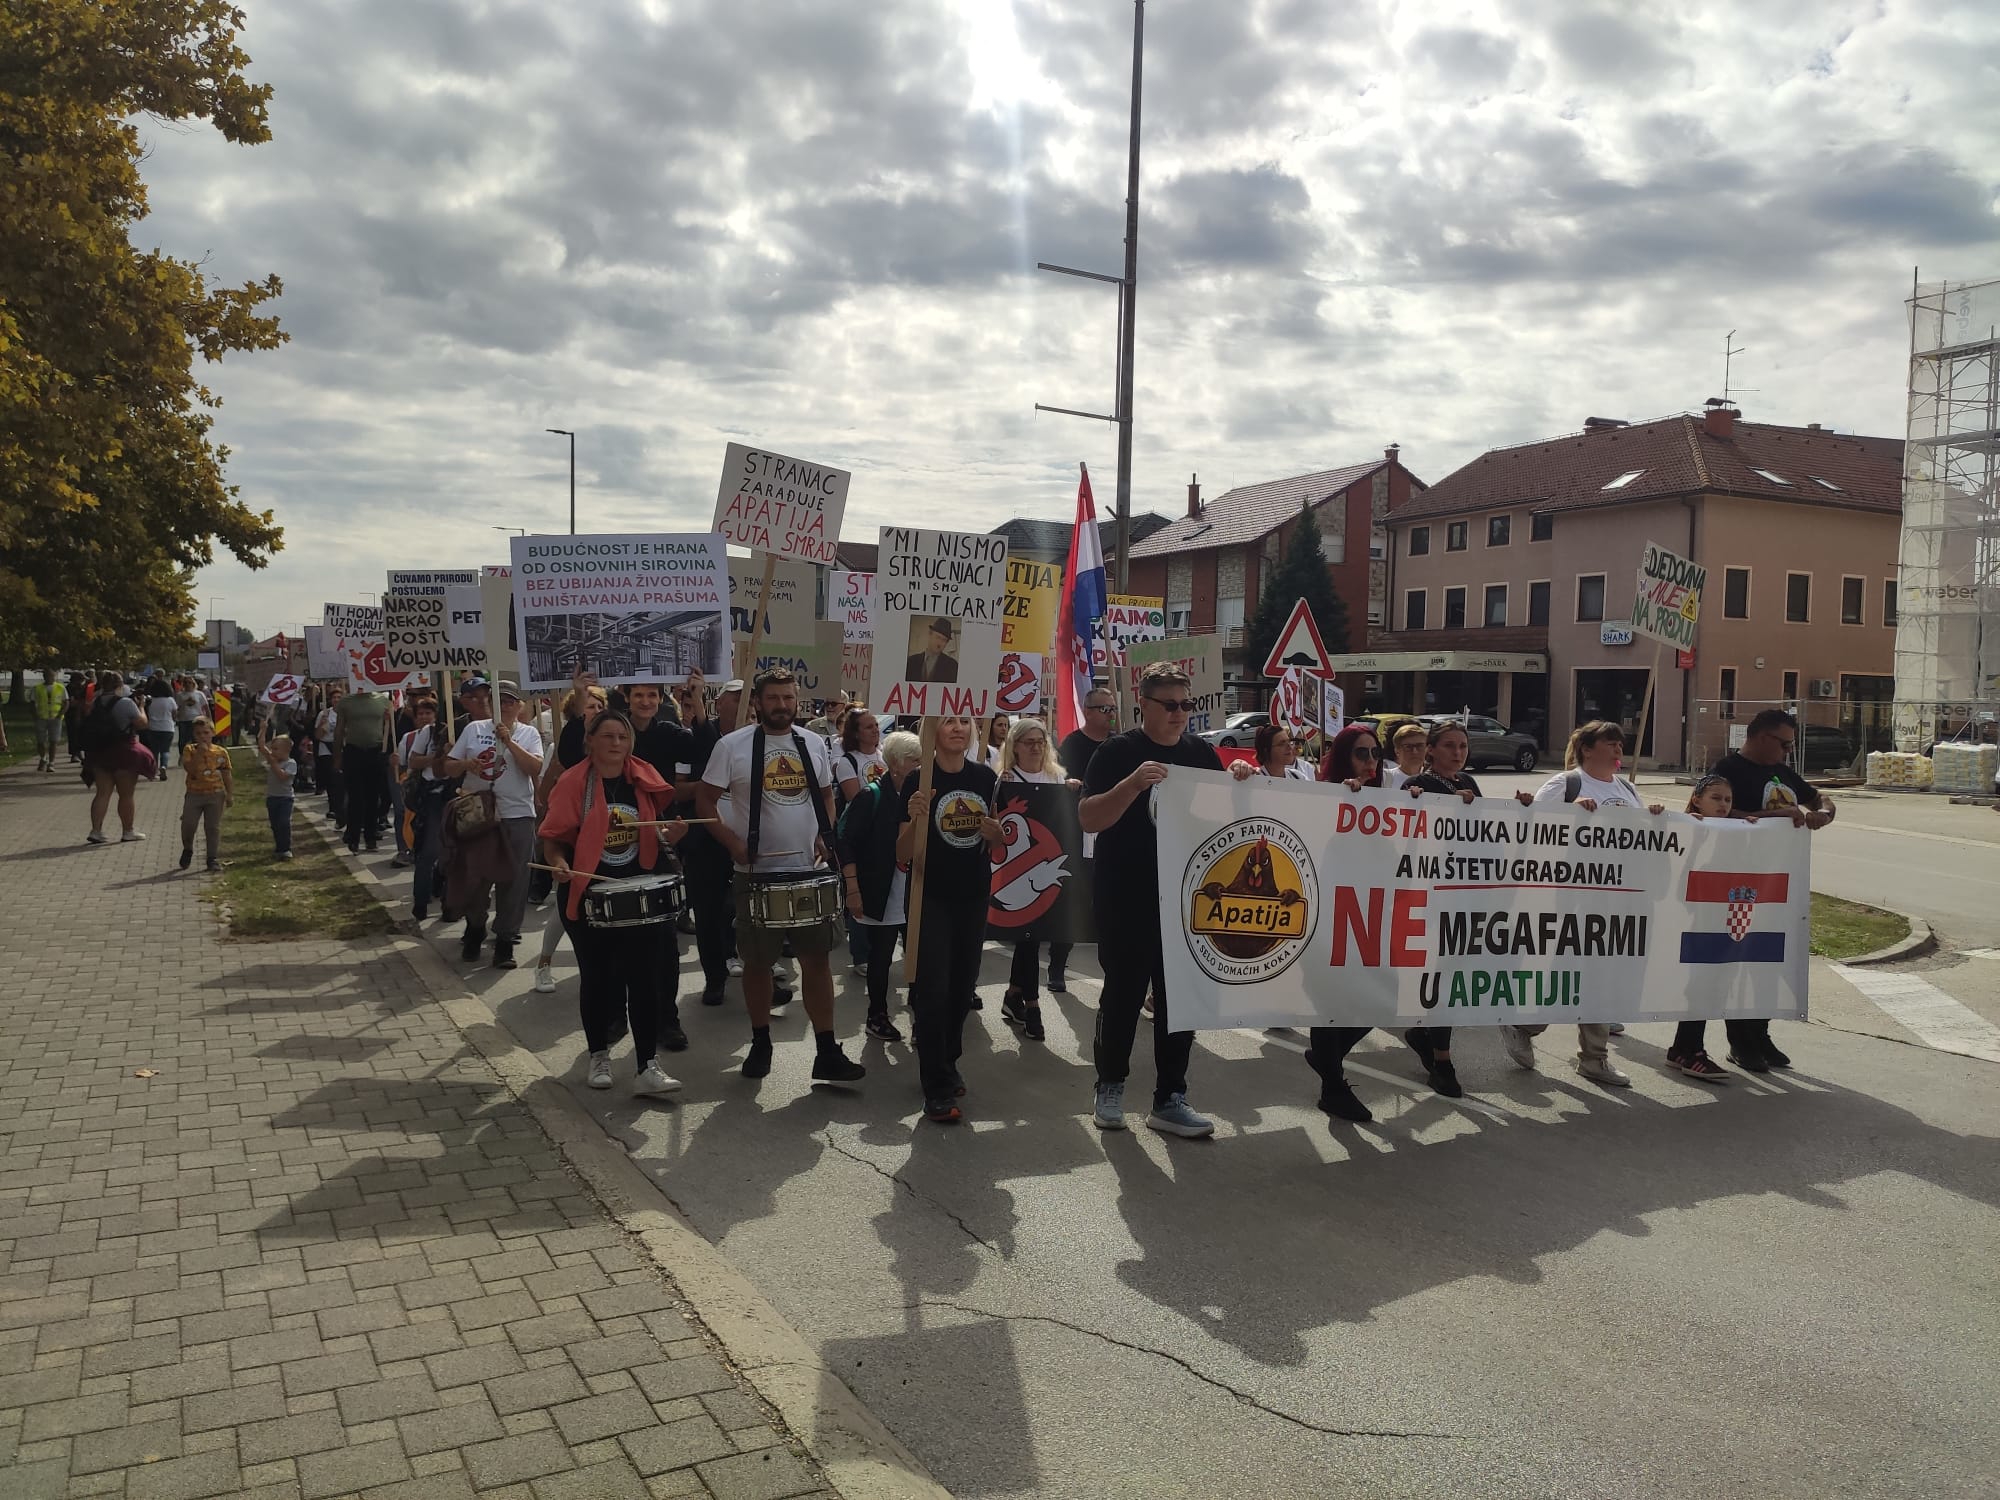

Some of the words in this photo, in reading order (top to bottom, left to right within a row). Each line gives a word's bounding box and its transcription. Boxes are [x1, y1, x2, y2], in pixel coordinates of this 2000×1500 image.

[744, 452, 837, 495] STRANAC
[739, 478, 825, 511] ZARAĐUJE
[726, 494, 825, 537] APATIJA
[528, 541, 630, 557] BUDUĆNOST
[633, 543, 649, 555] JE
[653, 543, 708, 555] HRANA
[718, 519, 770, 548] GUTA
[781, 532, 837, 562] SMRAD
[937, 533, 1006, 563] NISMO
[434, 573, 473, 584] PRIRODU
[522, 563, 546, 575] OD
[550, 561, 637, 573] OSNOVNIH
[641, 559, 716, 571] SIROVINA
[526, 578, 555, 591] BEZ
[559, 576, 632, 589] UBIJANJA
[636, 573, 714, 587] ŽIVOTINJA
[392, 585, 445, 596] POŠTUJEMO
[522, 597, 527, 608] I
[531, 592, 640, 608] UNIŠTAVANJA
[643, 589, 719, 604] PRAŠUMA
[908, 581, 920, 590] MI
[932, 582, 959, 593] SMO
[384, 598, 444, 613] NAROD
[1631, 592, 1650, 630] NA
[386, 614, 441, 629] REKAO
[1602, 632, 1630, 641] SHARK
[388, 649, 441, 669] VOLJU
[883, 682, 927, 714] AM
[940, 686, 988, 716] NAJ
[771, 776, 806, 786] Apatija
[948, 817, 982, 828] Apatija
[1336, 803, 1428, 839] DOSTA
[1434, 817, 1510, 844] ODLUKA
[1516, 821, 1529, 844] U
[1533, 822, 1569, 847] IME
[1574, 825, 1685, 857] GRAĐANA,
[1202, 831, 1235, 861] STOP
[1240, 824, 1275, 838] FARMI
[1396, 854, 1413, 878] A
[1418, 856, 1441, 879] NA
[1444, 852, 1508, 881] ŠTETU
[1511, 860, 1623, 886] GRAĐANA!
[1207, 900, 1291, 931] Apatija
[1330, 886, 1428, 968] NE
[1438, 911, 1648, 957] MEGAFARMI
[1199, 944, 1216, 966] SELO
[1217, 961, 1260, 976] DOMAĆIH
[1264, 950, 1291, 971] KOKA
[1419, 971, 1441, 1009] U
[1447, 970, 1581, 1008] APATIJI!
